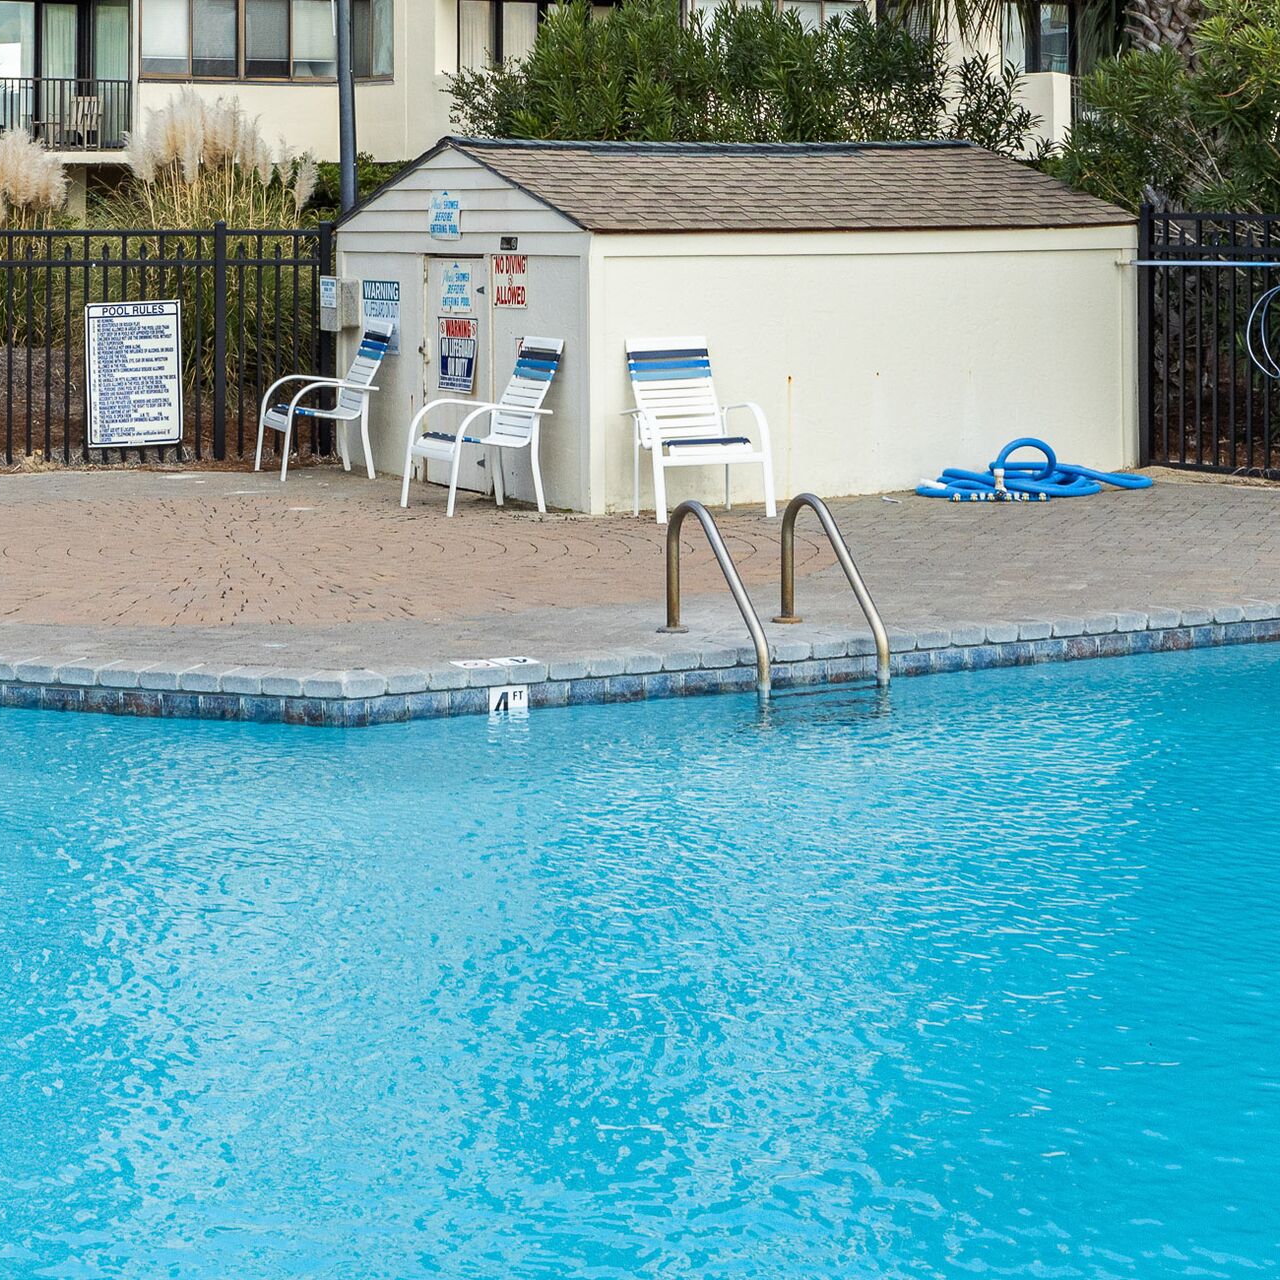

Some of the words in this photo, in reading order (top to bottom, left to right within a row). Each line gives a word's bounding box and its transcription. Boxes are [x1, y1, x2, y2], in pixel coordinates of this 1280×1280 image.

[435, 212, 453, 221] BEFORE
[430, 224, 447, 233] ENTERING
[495, 255, 504, 274] NO
[505, 255, 526, 274] DIVING
[364, 281, 399, 300] WARNING
[447, 285, 466, 294] BEFORE
[496, 286, 526, 305] ALLOWED
[442, 296, 459, 306] ENTERING
[102, 306, 130, 316] POOL
[132, 305, 165, 315] RULES
[446, 320, 471, 338] WARNING
[441, 338, 449, 356] NO
[449, 338, 474, 358] LIFEGUARD
[455, 358, 469, 377] DUTY
[494, 691, 509, 712] 4
[512, 690, 524, 701] FT
